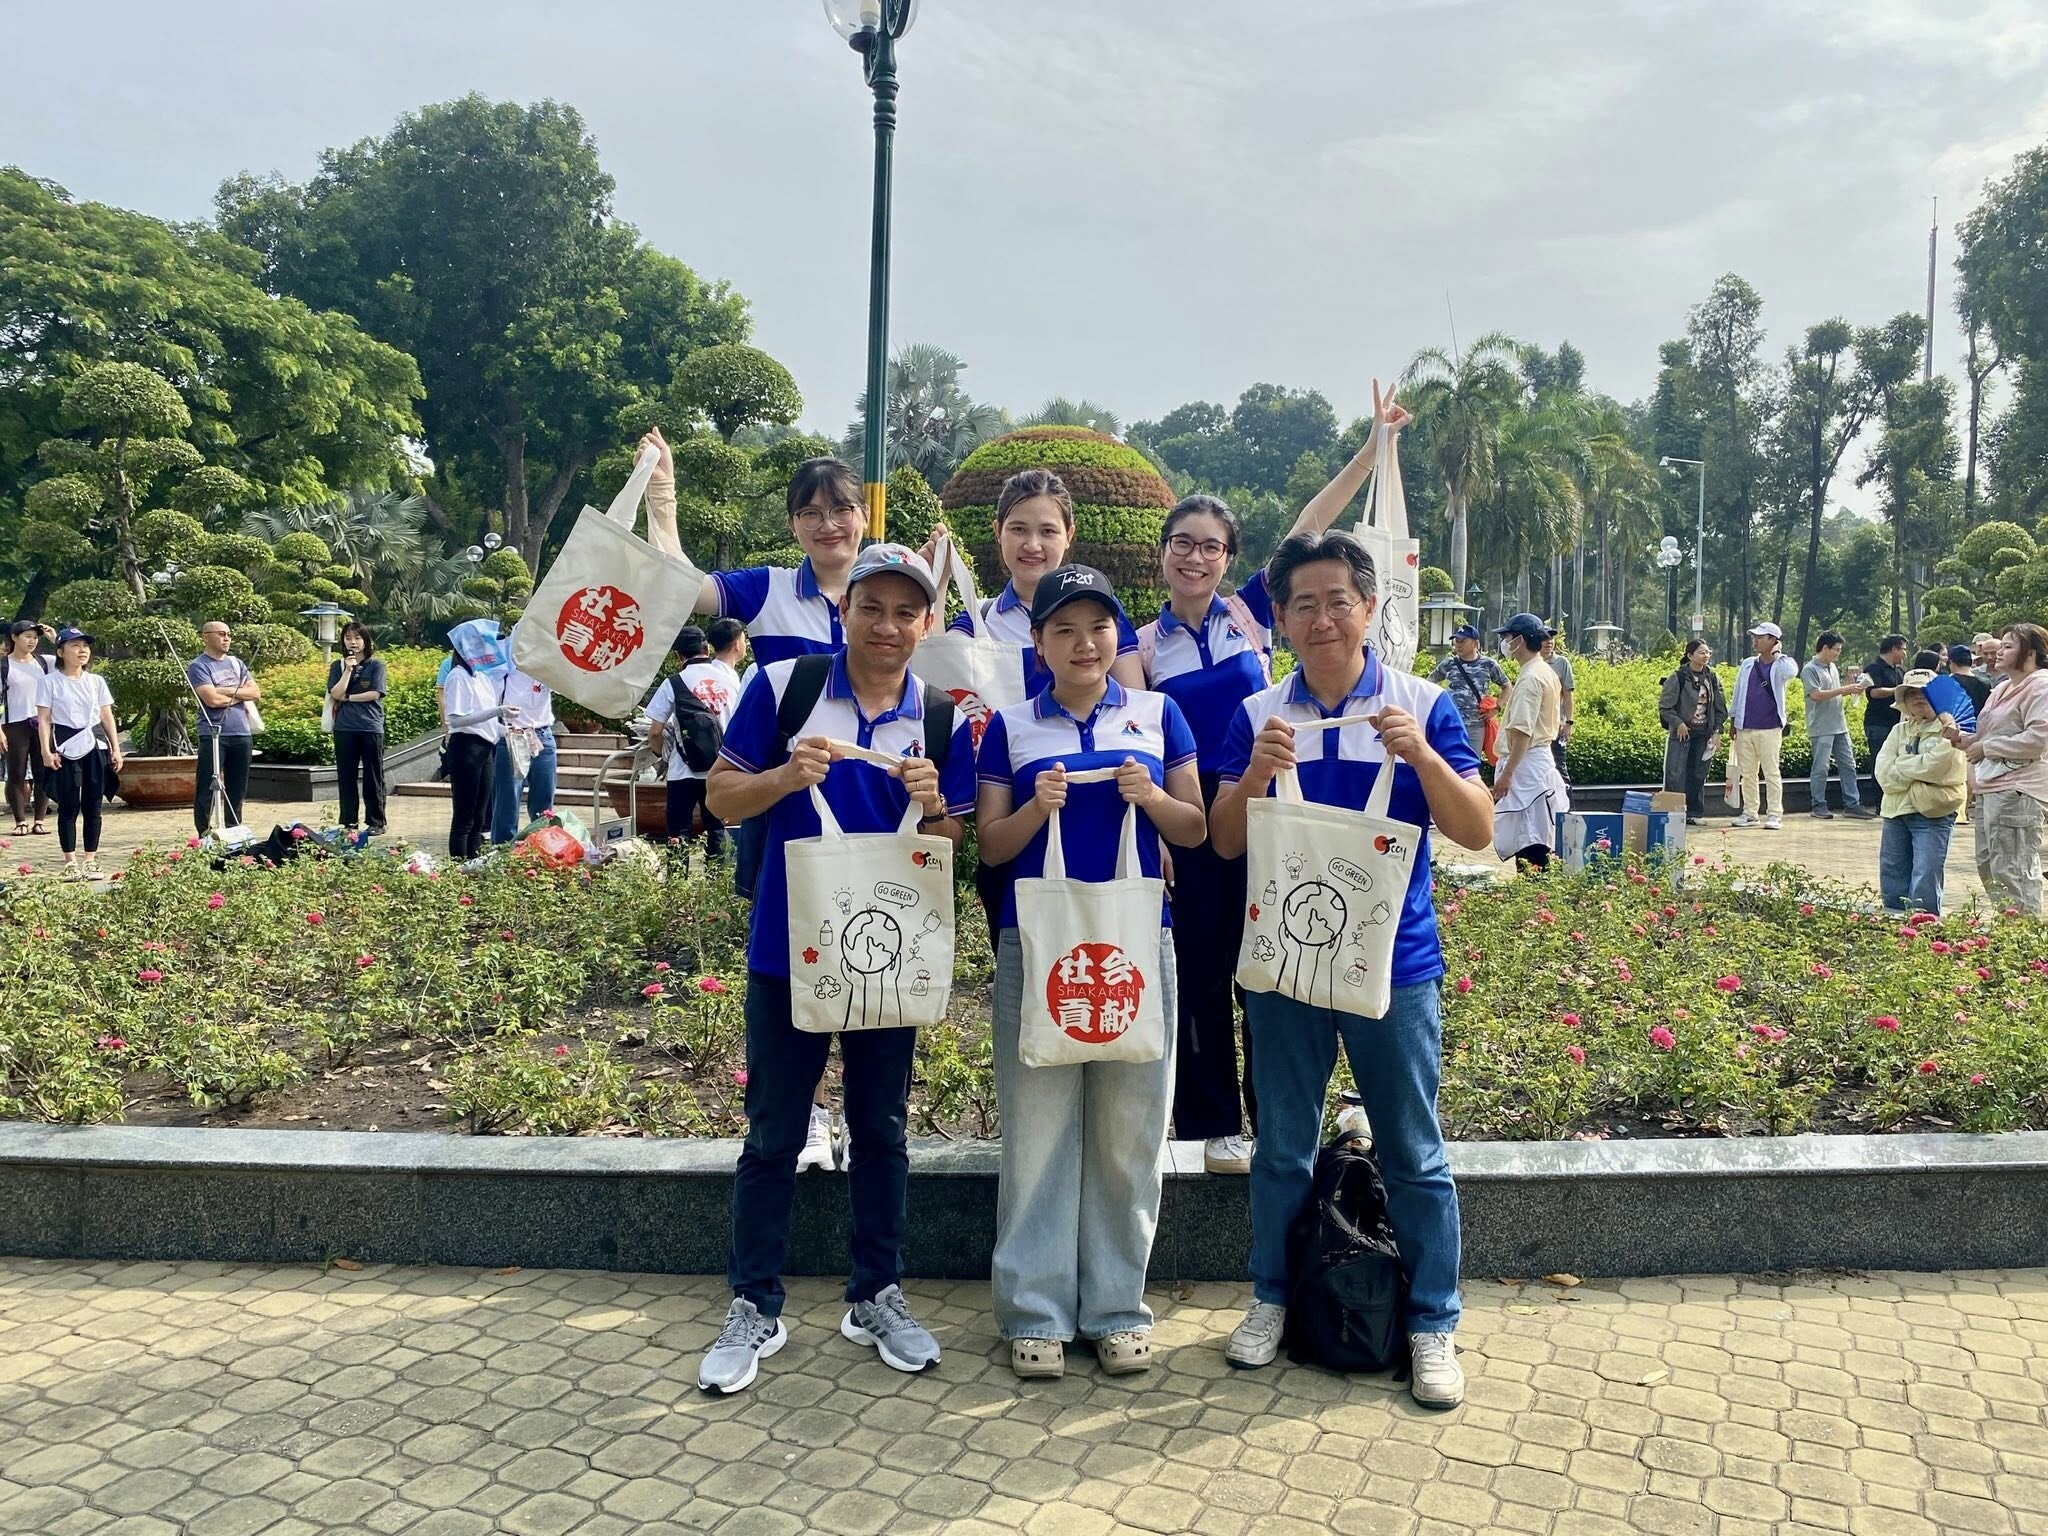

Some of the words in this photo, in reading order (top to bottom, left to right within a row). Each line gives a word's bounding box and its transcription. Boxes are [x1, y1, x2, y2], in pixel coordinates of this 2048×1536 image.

[571, 608, 632, 647] SHAKAKEN
[579, 587, 640, 637] 社会
[1332, 861, 1344, 872] GO
[1345, 868, 1367, 885] GREEN
[878, 885, 889, 894] GO
[891, 888, 912, 901] GREEN
[1057, 949, 1134, 986] 社会
[1057, 985, 1135, 998] SHAKAKEN
[1056, 997, 1136, 1033] 貢献
